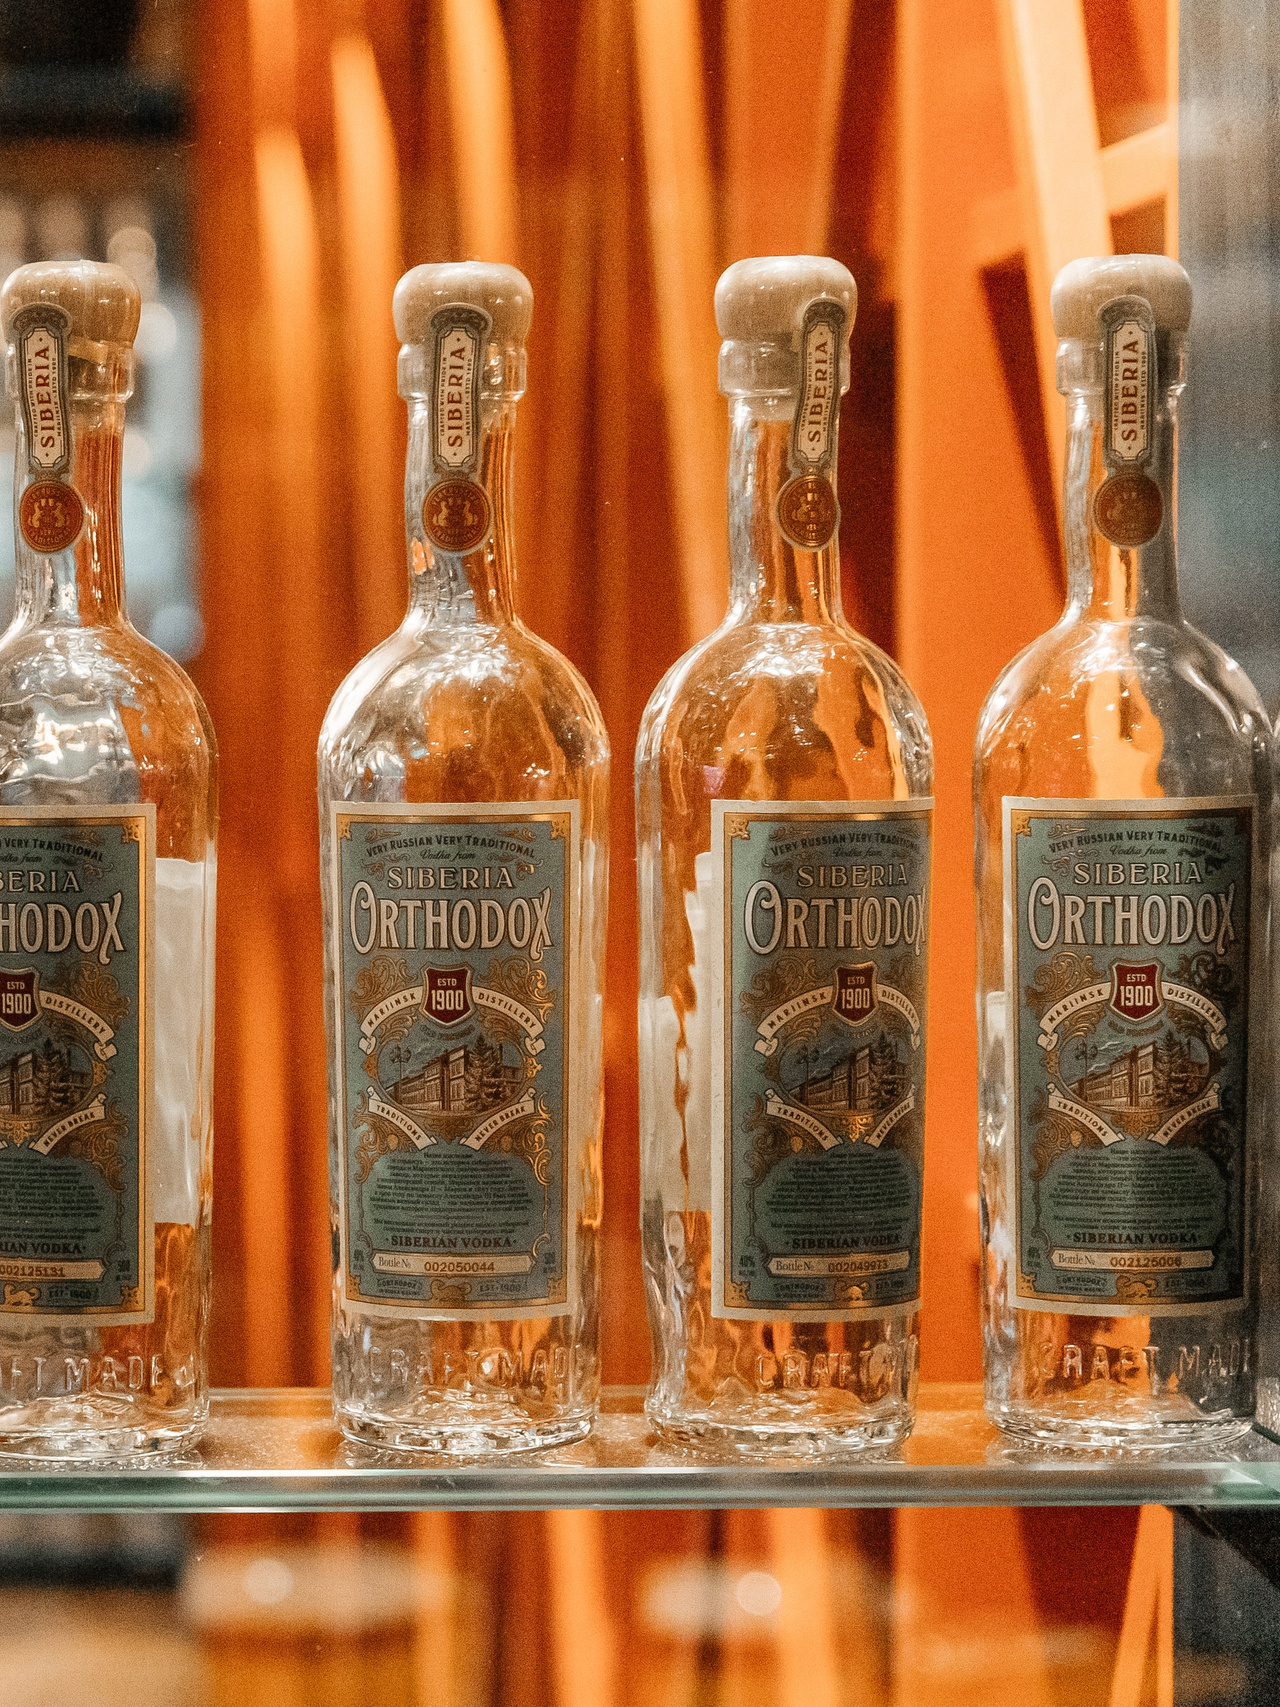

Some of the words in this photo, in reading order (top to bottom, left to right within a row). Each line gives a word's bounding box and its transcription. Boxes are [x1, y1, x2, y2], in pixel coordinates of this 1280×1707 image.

[35, 346, 55, 448] SIBERIA
[447, 347, 465, 447] SIBERIA
[807, 341, 828, 443] SIBERIA
[1121, 341, 1138, 441] SIBERIA
[5, 838, 29, 849] VERY
[32, 838, 104, 861] TRADITIONAL
[366, 844, 388, 858] VERY
[390, 837, 432, 850] RUSSIAN
[436, 835, 463, 846] VERY
[465, 835, 536, 858] TRADITIONAL
[770, 841, 798, 857] VERY
[800, 834, 846, 849] RUSSIAN
[849, 833, 872, 843] VERY
[1049, 839, 1074, 853] VERY
[1077, 832, 1123, 847] RUSSIAN
[1126, 830, 1154, 841] VERY
[387, 867, 516, 889] SIBERIA
[797, 865, 908, 887] SIBERIA
[1074, 862, 1203, 885] SIBERIA
[350, 880, 554, 962] ORTHODOX
[1028, 876, 1236, 954] ORTHODOX
[7, 982, 24, 990] ESTD
[438, 978, 457, 986] ESTD
[848, 977, 865, 985] ESTD
[1127, 973, 1146, 982] ESTD
[1, 994, 31, 1014] 1900
[432, 990, 464, 1011] 1900
[841, 988, 870, 1009] 1900
[1048, 989, 1104, 1024] MARIINSK
[1167, 989, 1221, 1025] DISTILLERY
[1120, 985, 1153, 1007] 1900
[46, 996, 107, 1034] DISTILLERY
[368, 993, 416, 1028] MARIINSK
[478, 992, 537, 1029] DISTILLERY
[767, 991, 827, 1029] MARIINSK
[43, 1125, 66, 1147] NEVER
[68, 1111, 96, 1130] BREAK
[376, 1105, 421, 1140] TRADITIONS
[475, 1119, 499, 1142] NEVER
[501, 1105, 527, 1123] BREAK
[777, 1107, 828, 1141] TRADITIONS
[876, 1118, 893, 1139] NEVER
[1057, 1101, 1108, 1137] TRADITIONS
[1163, 1117, 1185, 1137] NEVER
[1187, 1101, 1212, 1120] BREAK
[31, 1242, 82, 1254] VODKA
[391, 1236, 457, 1248] SIBERIAN
[462, 1236, 511, 1249] VODKA
[792, 1237, 859, 1249] SIBERIAN
[863, 1234, 899, 1247] VODKA
[1073, 1233, 1144, 1243] SIBERIAN
[1148, 1233, 1197, 1244] VODKA
[424, 1261, 495, 1272] 002050044
